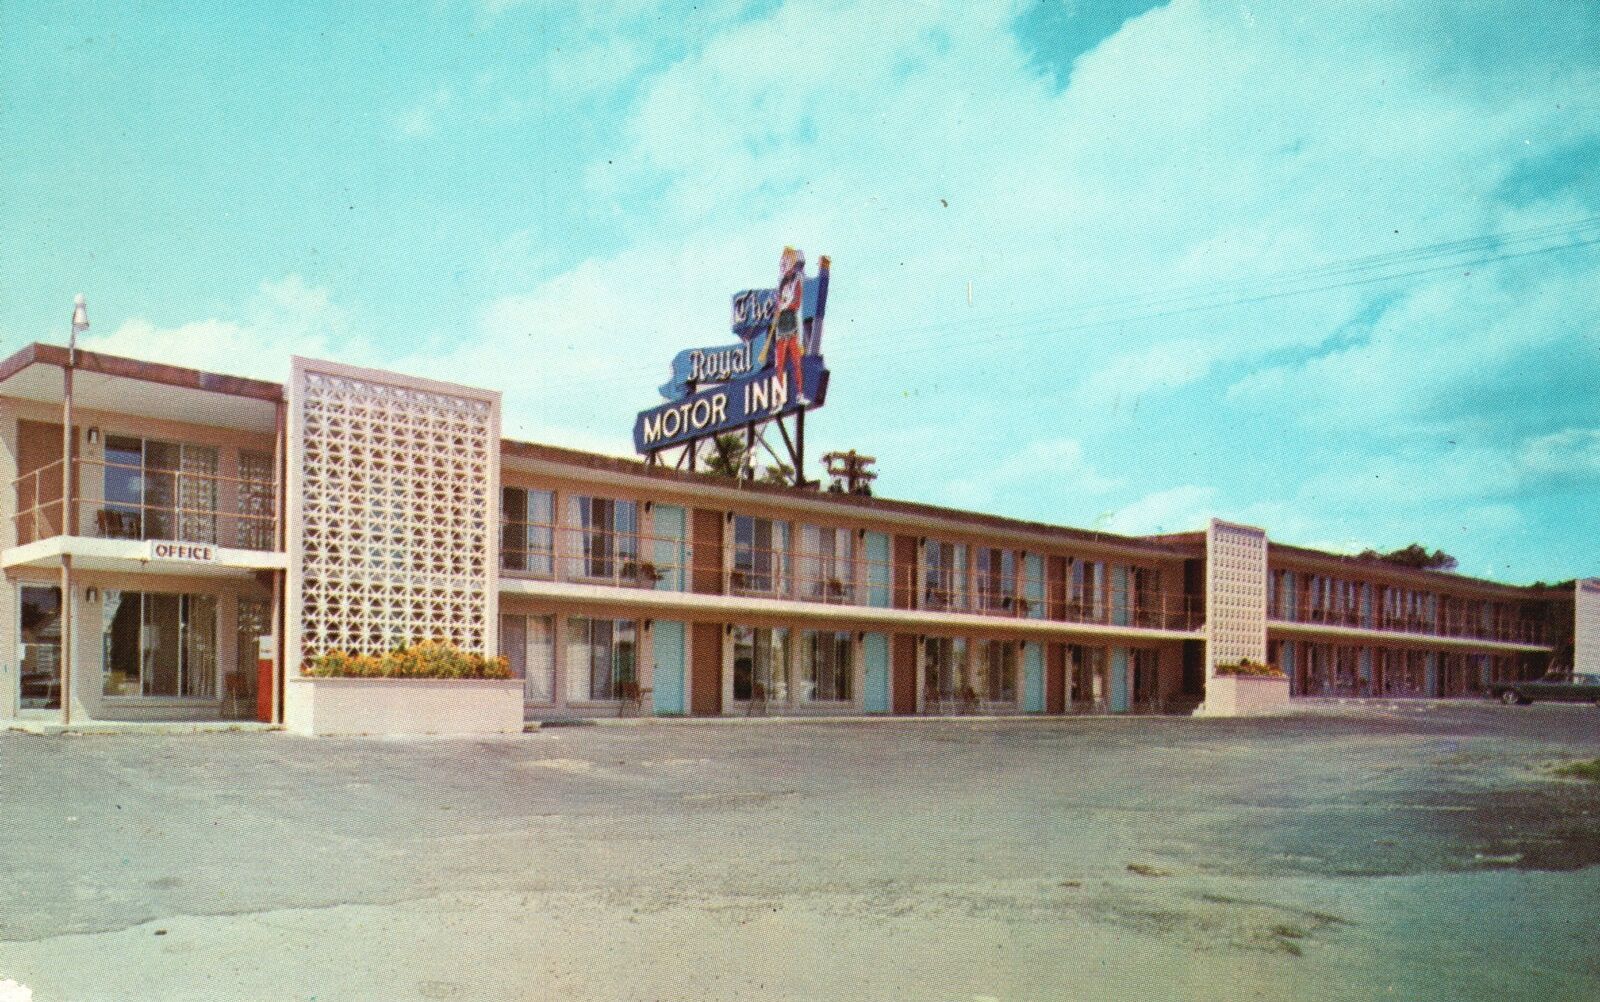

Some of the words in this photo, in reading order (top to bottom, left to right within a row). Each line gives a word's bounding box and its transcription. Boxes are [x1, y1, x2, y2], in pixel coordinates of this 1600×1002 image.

[734, 291, 775, 324] The
[688, 340, 753, 381] Royal
[643, 393, 727, 444] MOTOR
[744, 372, 789, 415] INN
[156, 544, 211, 560] OFFICE
